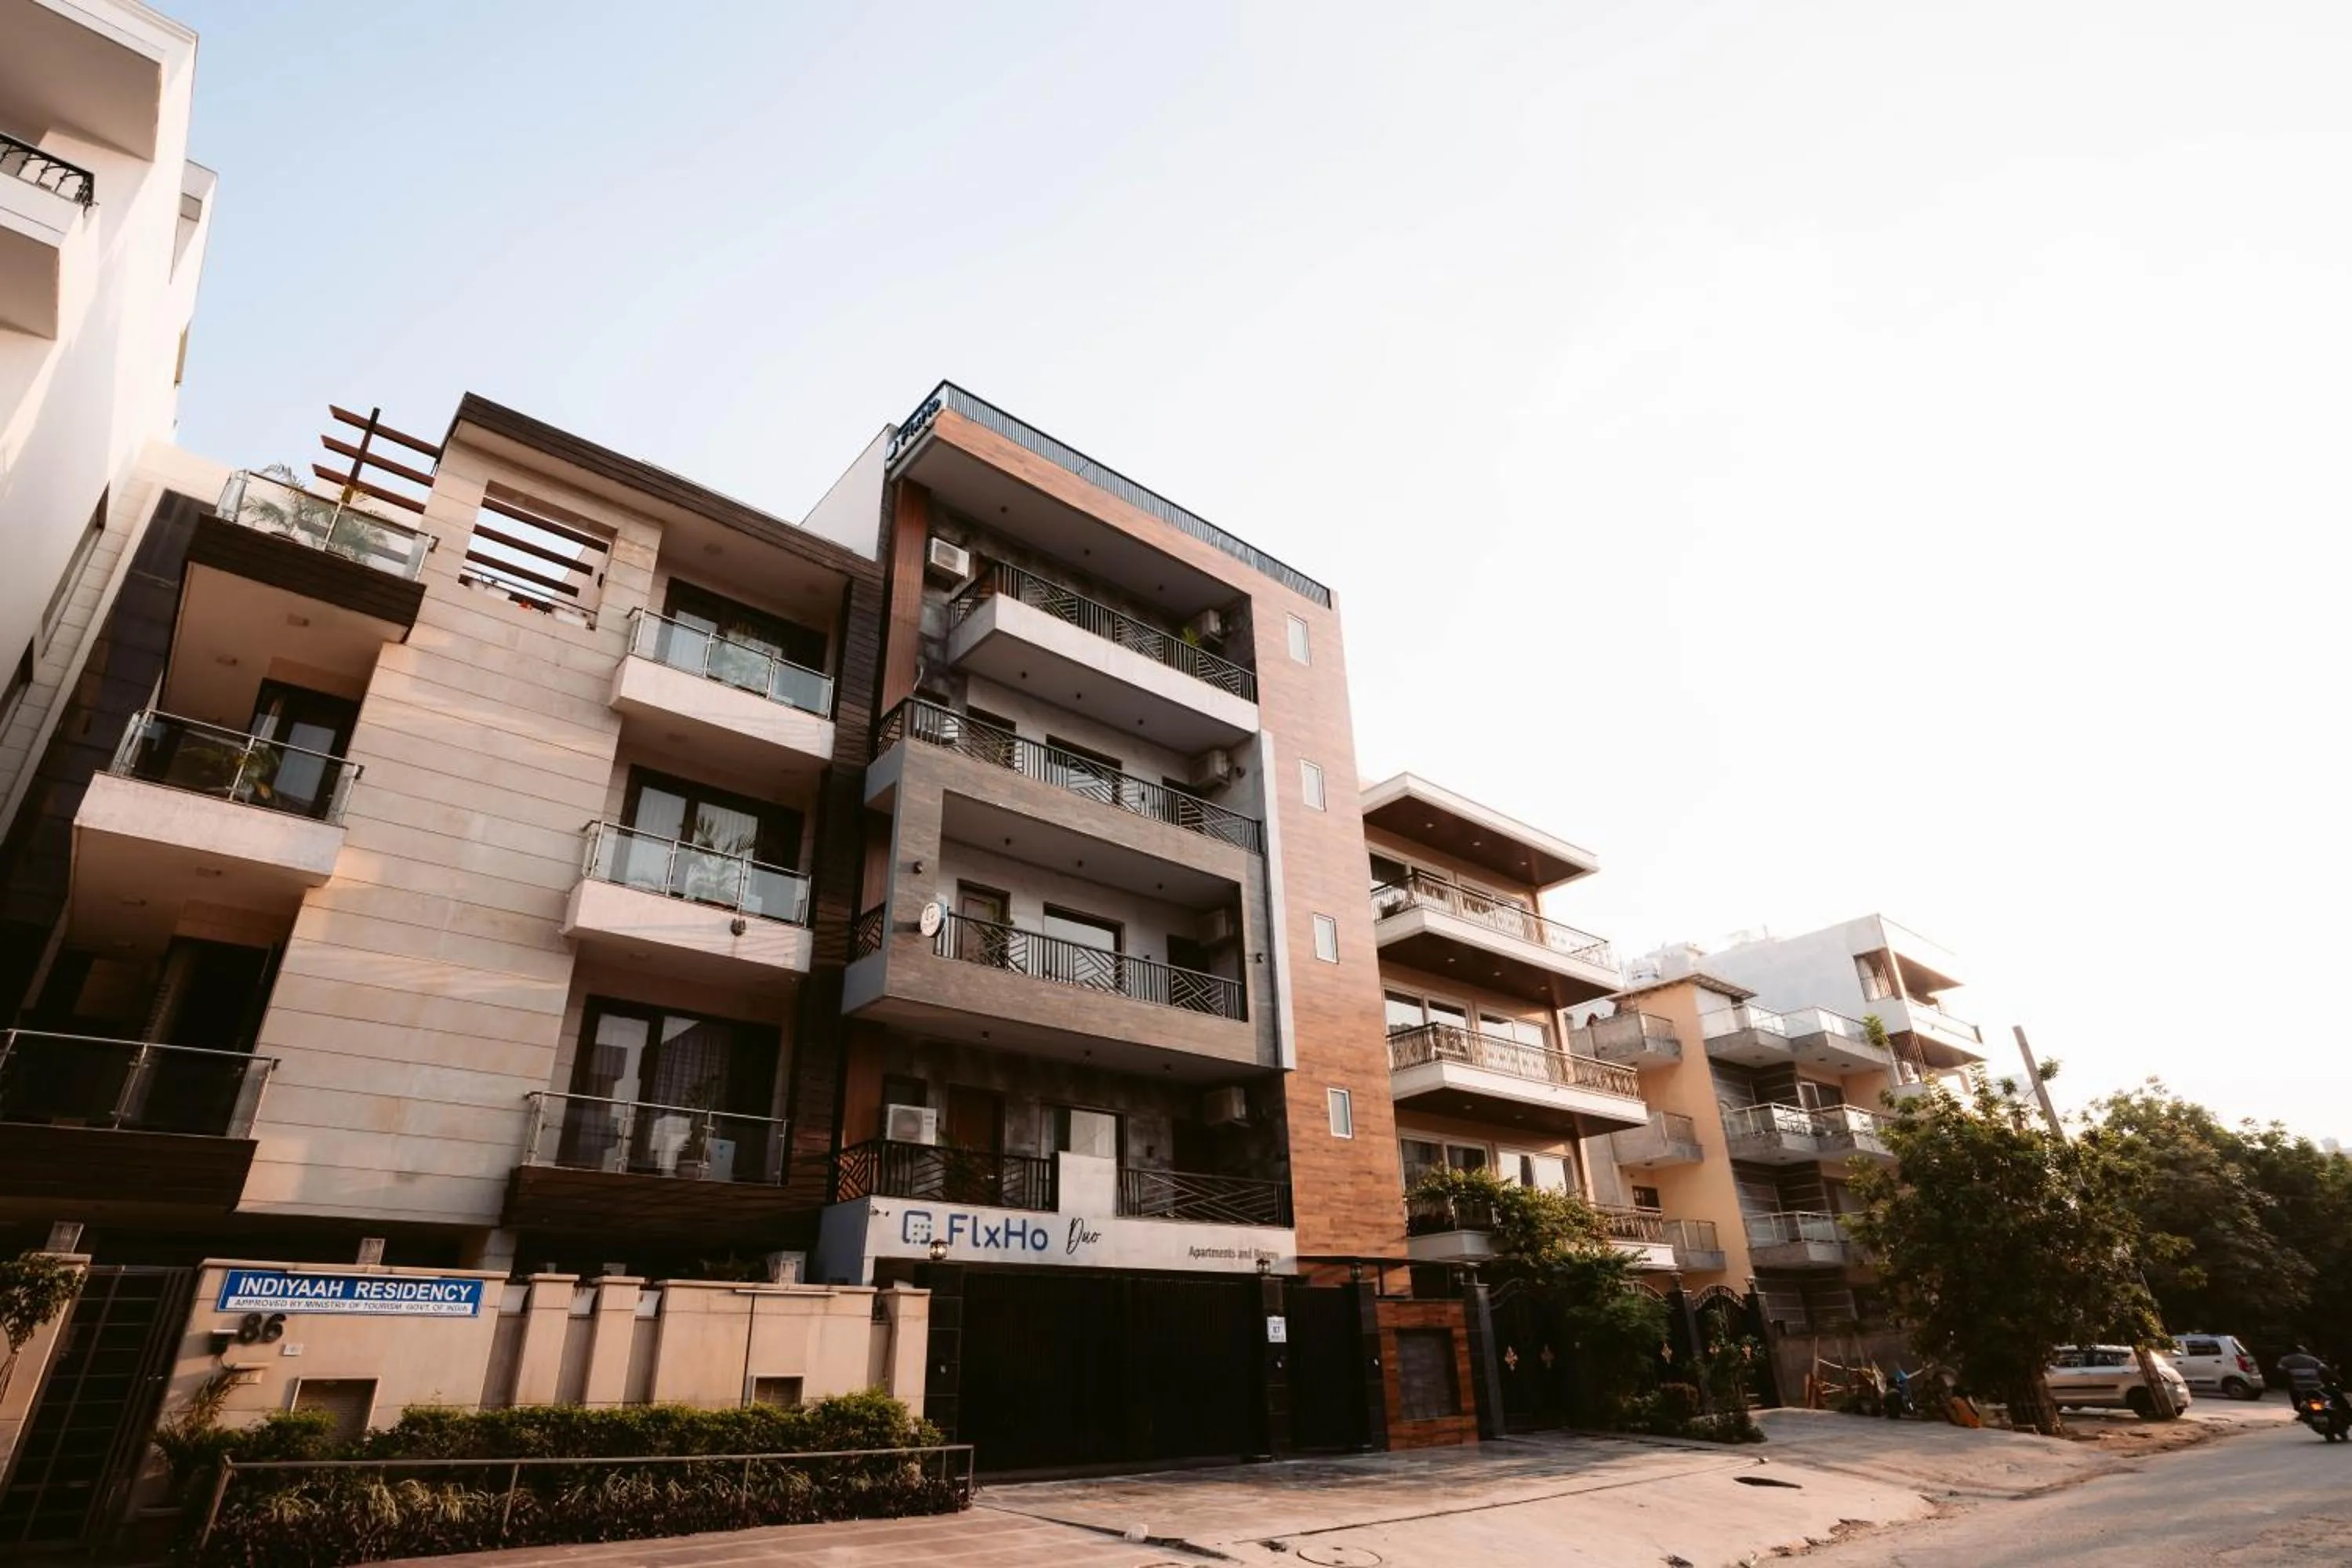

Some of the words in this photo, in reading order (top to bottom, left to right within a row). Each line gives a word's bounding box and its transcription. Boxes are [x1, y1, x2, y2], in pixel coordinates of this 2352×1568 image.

[949, 1214, 1048, 1251] FlxHo
[1066, 1218, 1102, 1254] Duo
[1189, 1246, 1236, 1259] Apartments
[1239, 1248, 1252, 1259] and
[238, 1277, 344, 1298] INDIYAAH
[354, 1281, 472, 1301] RESIDENCY
[235, 1298, 288, 1308] APPROVED
[238, 1312, 287, 1343] 86
